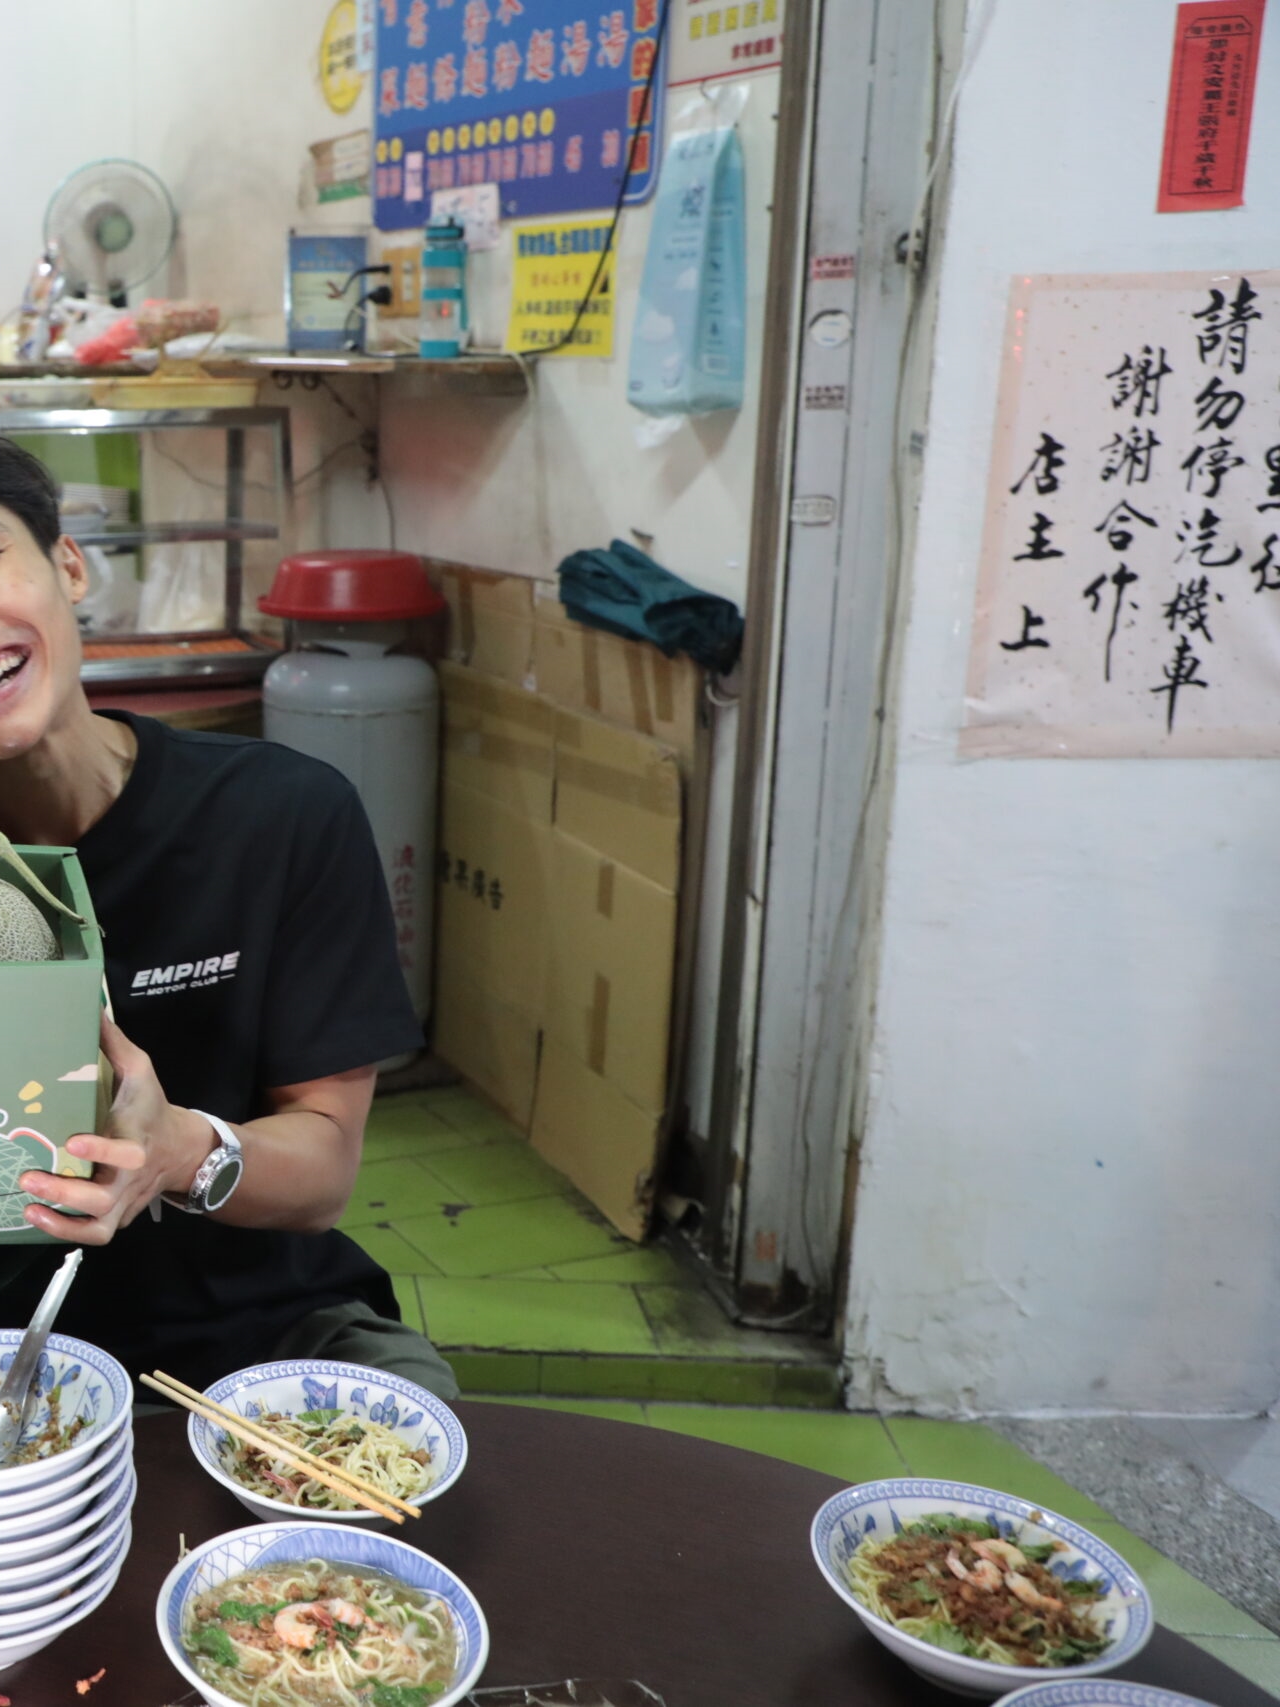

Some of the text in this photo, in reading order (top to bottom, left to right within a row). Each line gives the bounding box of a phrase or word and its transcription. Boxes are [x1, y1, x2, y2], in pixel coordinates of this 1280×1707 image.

[999, 432, 1066, 651] 店主上
[1084, 345, 1173, 682] 謝謝合作
[1150, 277, 1262, 735] 請勿停汽機車
[131, 950, 241, 988] EMPIRE
[146, 976, 219, 996] MOTOR CLUB
